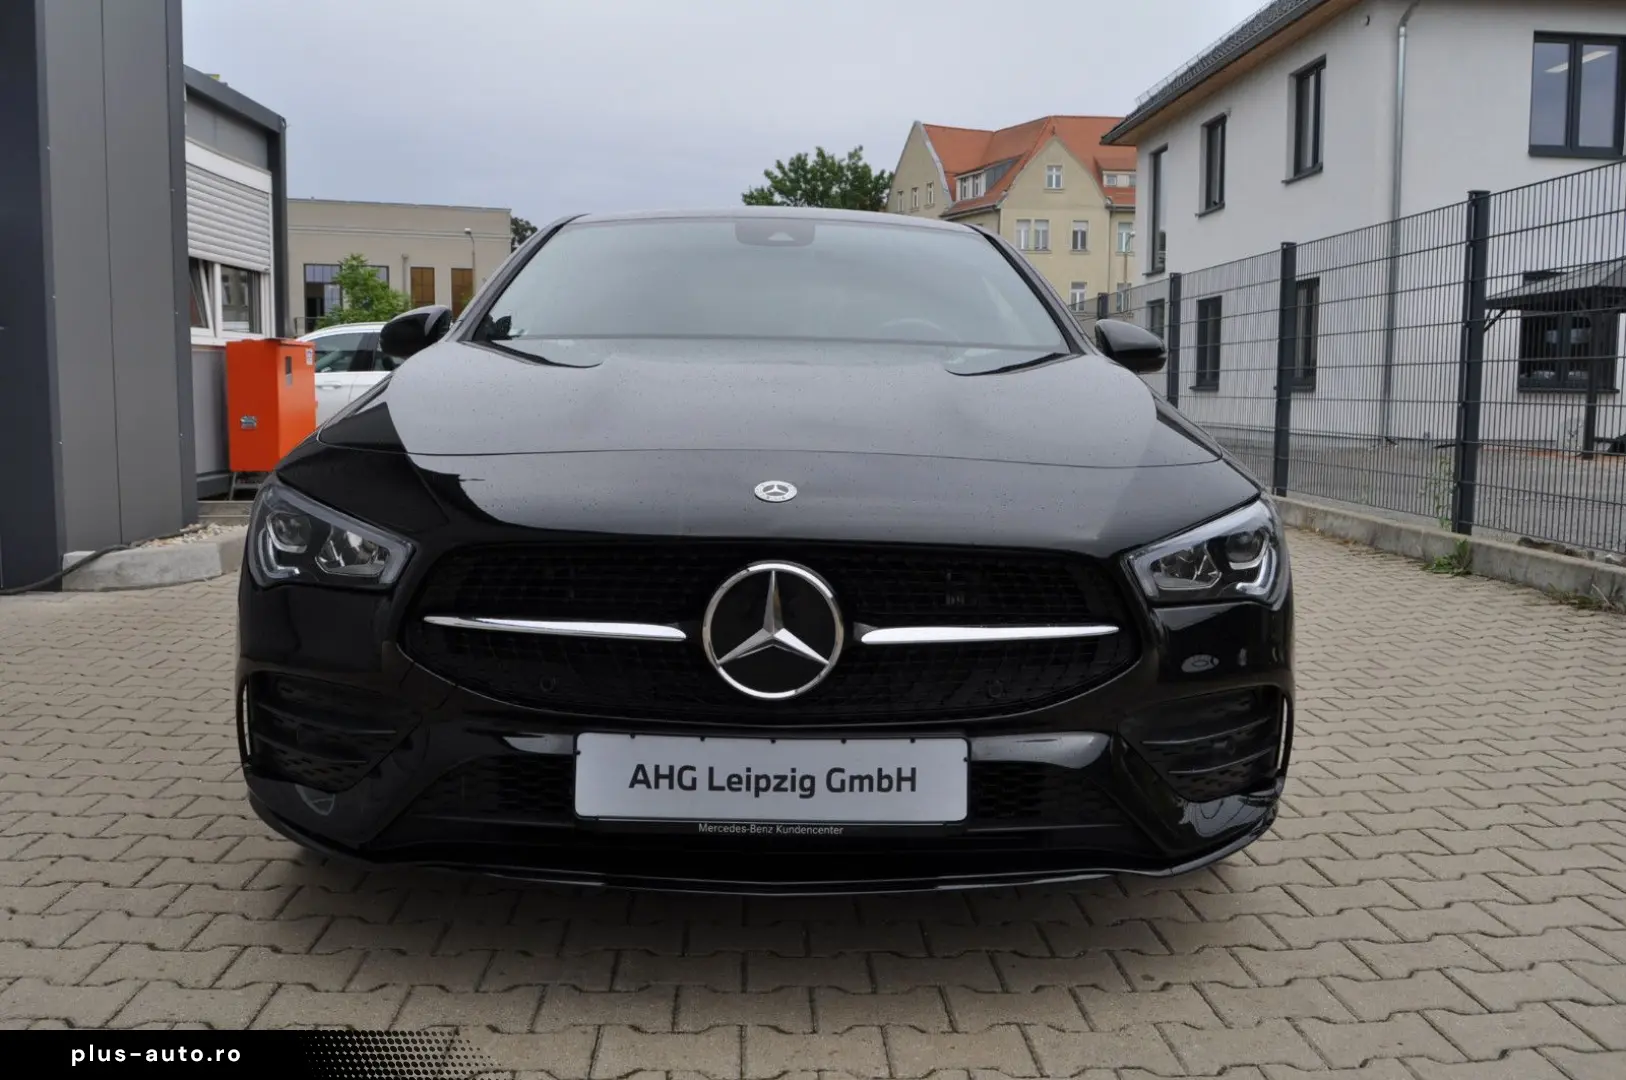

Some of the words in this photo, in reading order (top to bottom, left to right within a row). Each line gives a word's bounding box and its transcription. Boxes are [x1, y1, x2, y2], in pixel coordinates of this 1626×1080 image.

[628, 763, 697, 791] AHG
[707, 766, 816, 799] Leipzig
[825, 766, 917, 793] GmbH
[698, 823, 773, 835] Mercedes-Benz
[776, 824, 844, 836] Kundencenter
